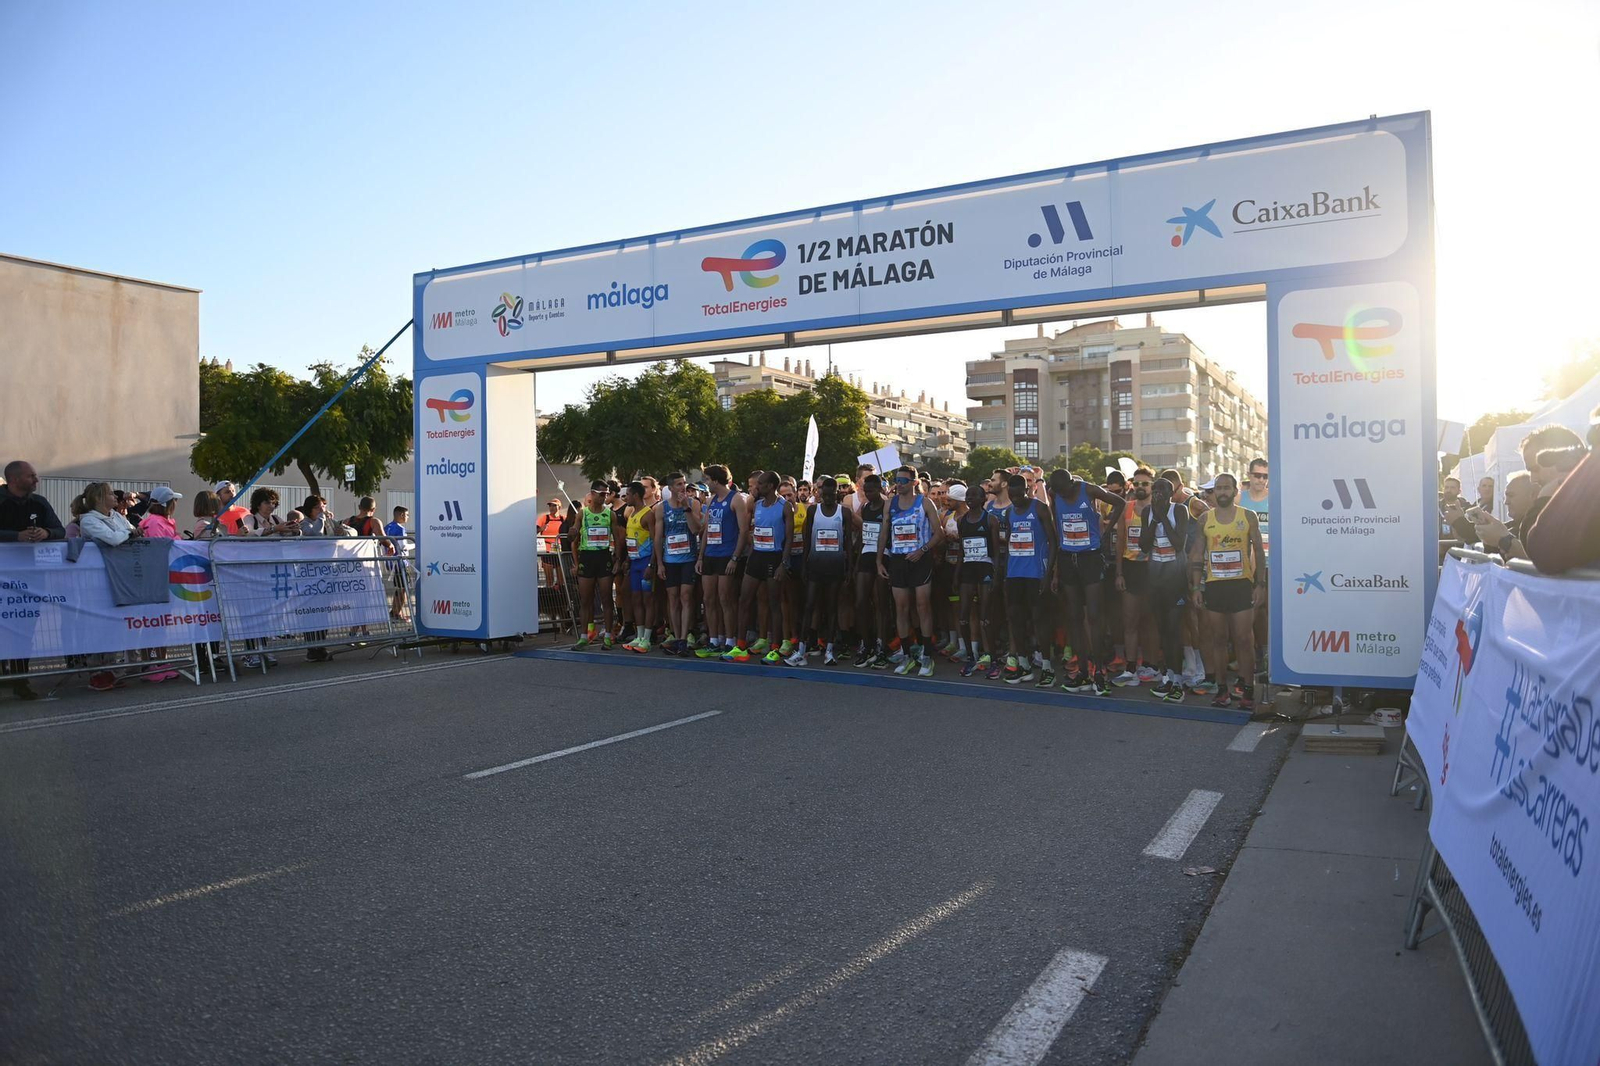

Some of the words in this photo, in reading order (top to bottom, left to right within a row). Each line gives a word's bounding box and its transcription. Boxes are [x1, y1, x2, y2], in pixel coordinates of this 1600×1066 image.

[1232, 185, 1381, 226] CaixaBank
[797, 240, 831, 263] 1/2
[837, 219, 954, 258] MARATÓN
[1003, 252, 1064, 271] Diputación
[1066, 245, 1124, 263] Provincial
[798, 274, 827, 295] DE
[832, 258, 934, 292] MÁLAGA
[1033, 268, 1048, 280] de
[1050, 263, 1092, 279] Málaga
[454, 308, 476, 318] metro
[702, 296, 787, 317] TotalEnergies
[455, 317, 478, 327] Málaga
[1293, 367, 1404, 385] TotalEnergies
[426, 428, 475, 439] TotalEnergies
[1301, 515, 1352, 526] Diputación
[1353, 515, 1401, 524] Provincial
[1326, 527, 1338, 535] de
[1340, 526, 1375, 536] Málaga
[442, 562, 476, 573] CaixaBank
[0, 580, 28, 590] añía
[295, 578, 366, 597] LasCarreras
[1330, 573, 1410, 589] CaixaBank
[7, 593, 67, 606] patrocina
[1, 608, 41, 619] eridas
[1356, 632, 1396, 642] metro
[1356, 643, 1401, 657] Málaga
[1489, 831, 1543, 933] totalenergies.es
